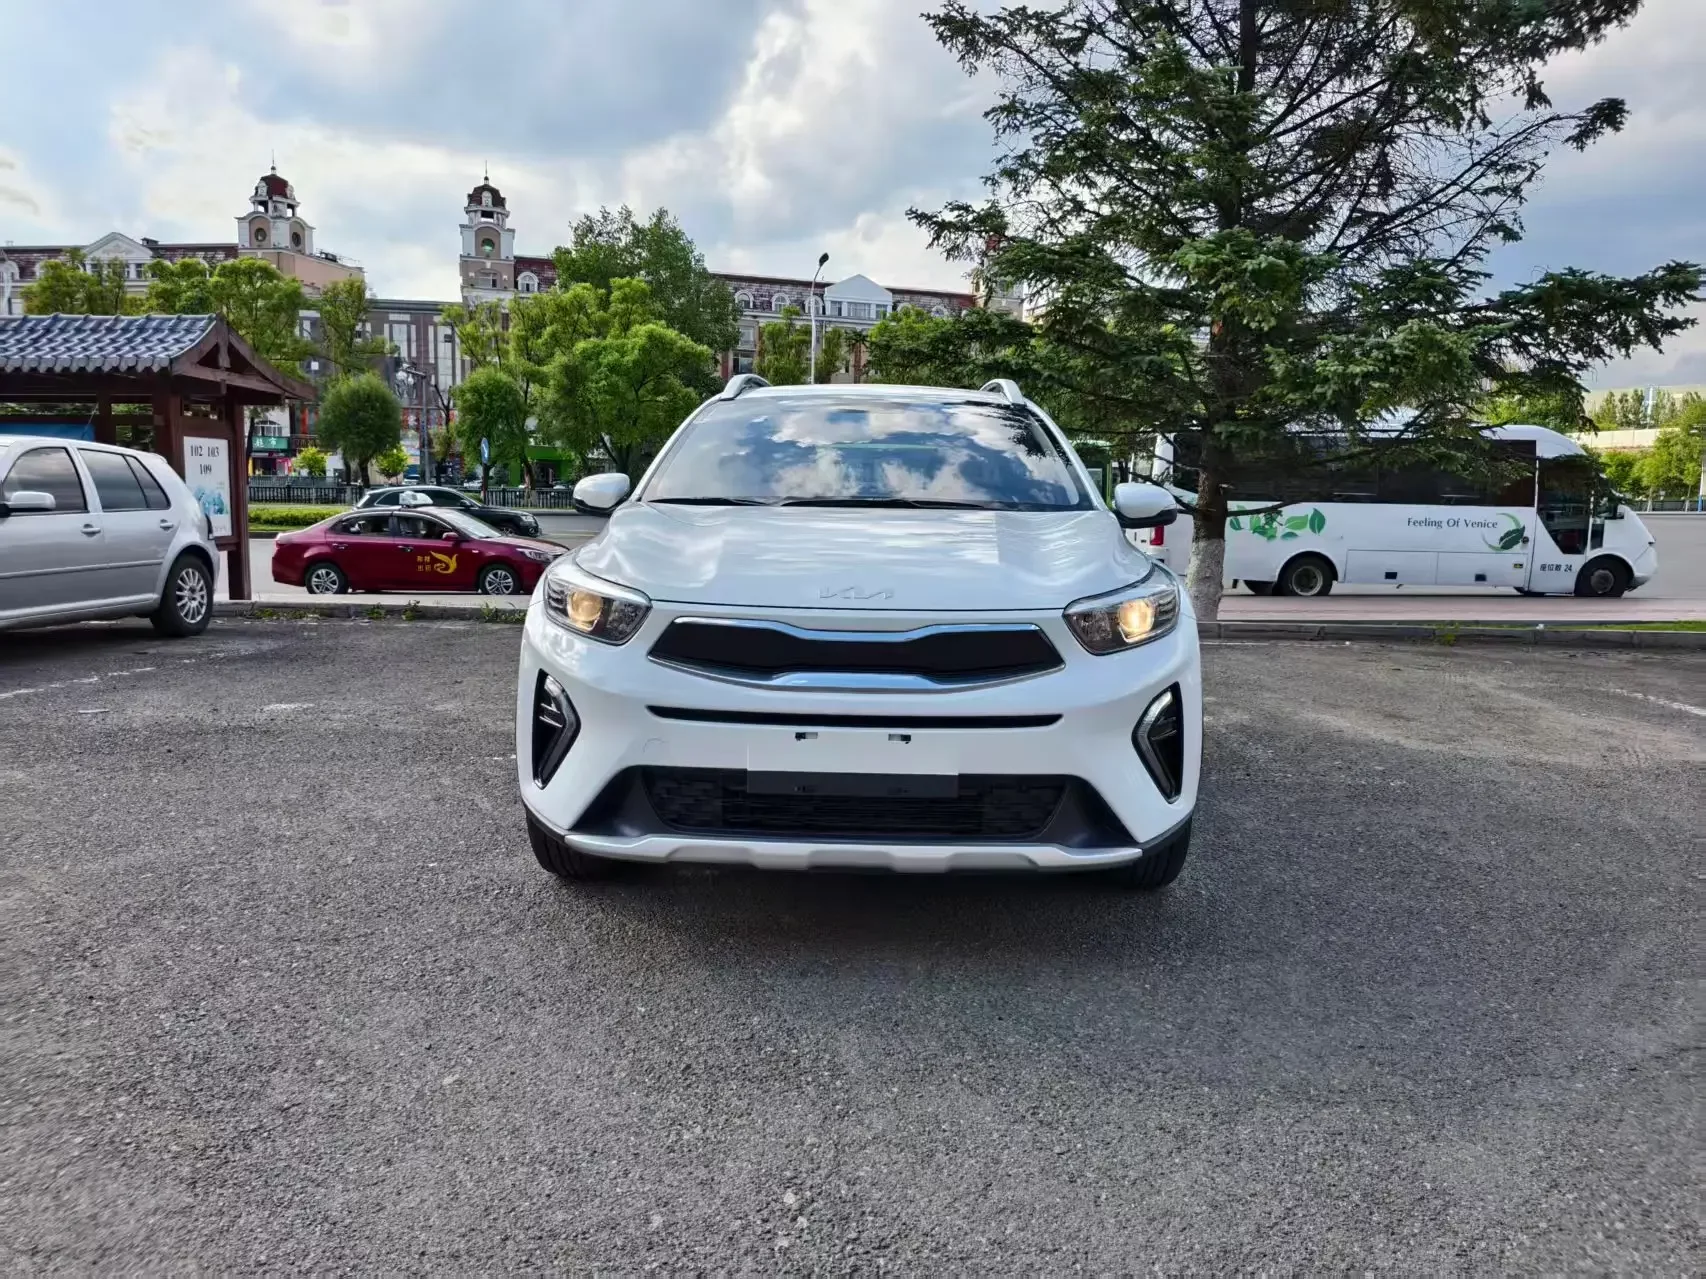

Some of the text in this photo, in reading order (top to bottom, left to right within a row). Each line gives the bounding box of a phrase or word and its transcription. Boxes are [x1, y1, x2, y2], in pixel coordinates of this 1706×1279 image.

[190, 445, 220, 458] 102 103
[200, 464, 212, 475] 109
[1407, 517, 1498, 529] Feeling Of Venice
[1564, 564, 1573, 573] 24
